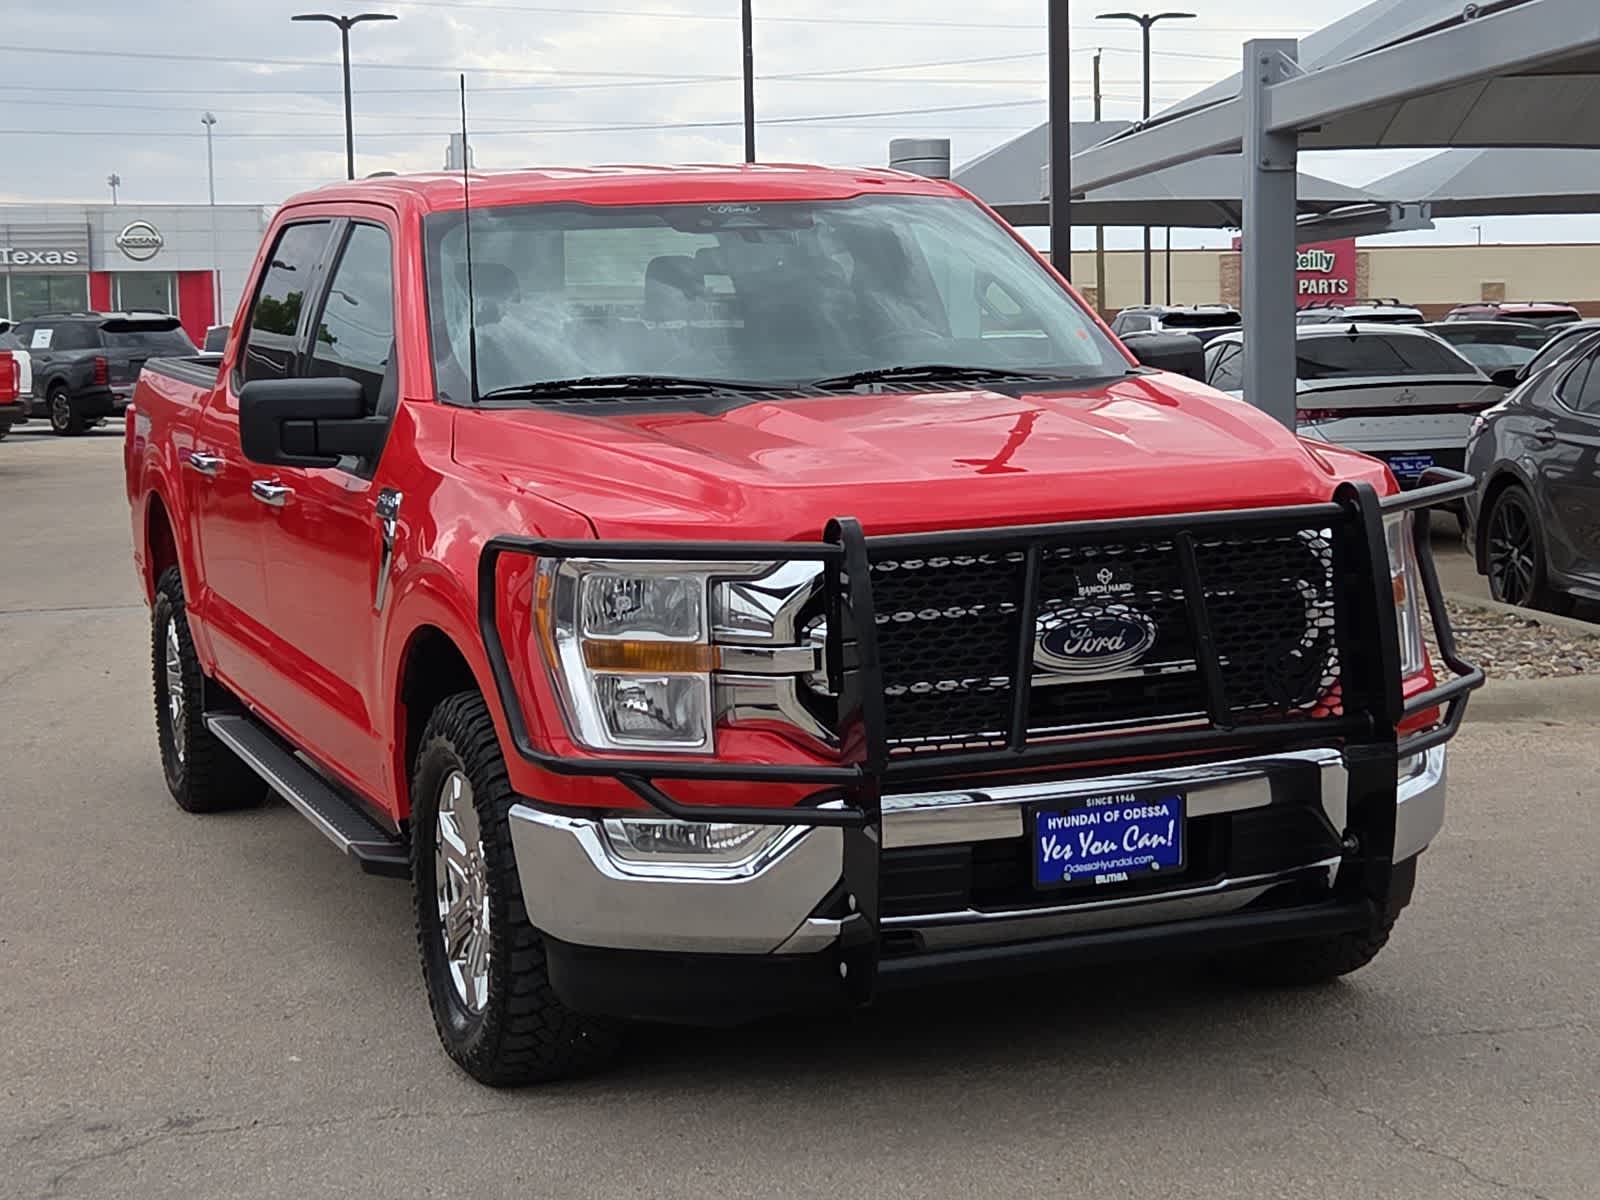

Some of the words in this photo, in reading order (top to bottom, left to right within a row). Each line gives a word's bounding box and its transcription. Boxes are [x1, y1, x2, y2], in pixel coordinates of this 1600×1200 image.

[0, 248, 78, 264] Texas
[1299, 279, 1348, 294] PARTS
[1063, 628, 1126, 654] Ford
[1086, 796, 1113, 807] SINCE
[1047, 812, 1100, 830] HYUNDAI
[1103, 810, 1120, 823] OF
[1123, 804, 1169, 820] ODESSA
[1041, 834, 1073, 863] Yes
[1078, 829, 1118, 858] You
[1122, 819, 1175, 851] Can!
